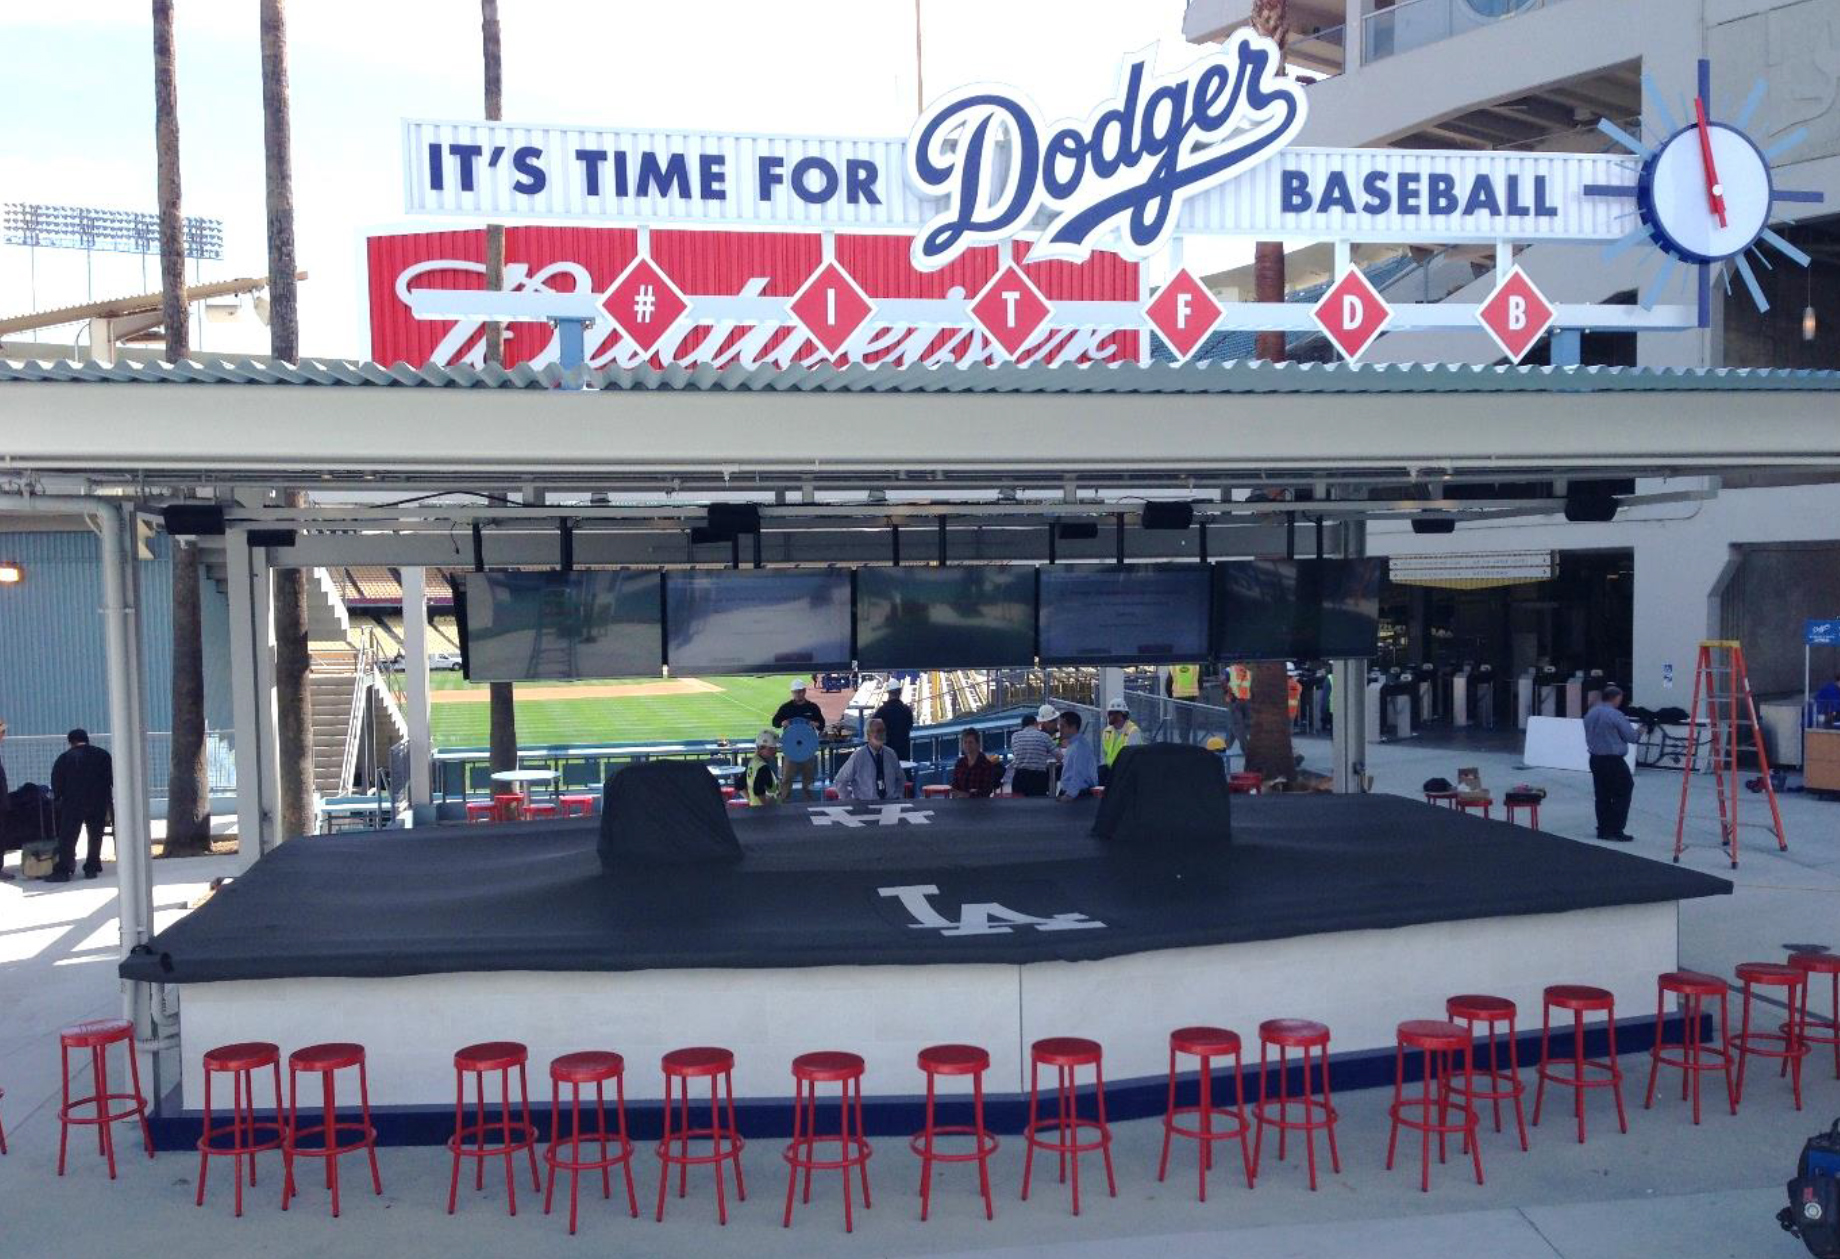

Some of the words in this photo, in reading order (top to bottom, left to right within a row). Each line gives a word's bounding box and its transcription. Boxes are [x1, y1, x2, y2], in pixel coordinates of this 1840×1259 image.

[428, 142, 547, 196] IT'S
[575, 148, 727, 200] TIME
[757, 155, 883, 205] FOR
[915, 39, 1298, 258] Dodger
[1280, 169, 1559, 218] BASEBALL
[876, 883, 1109, 937] LA
